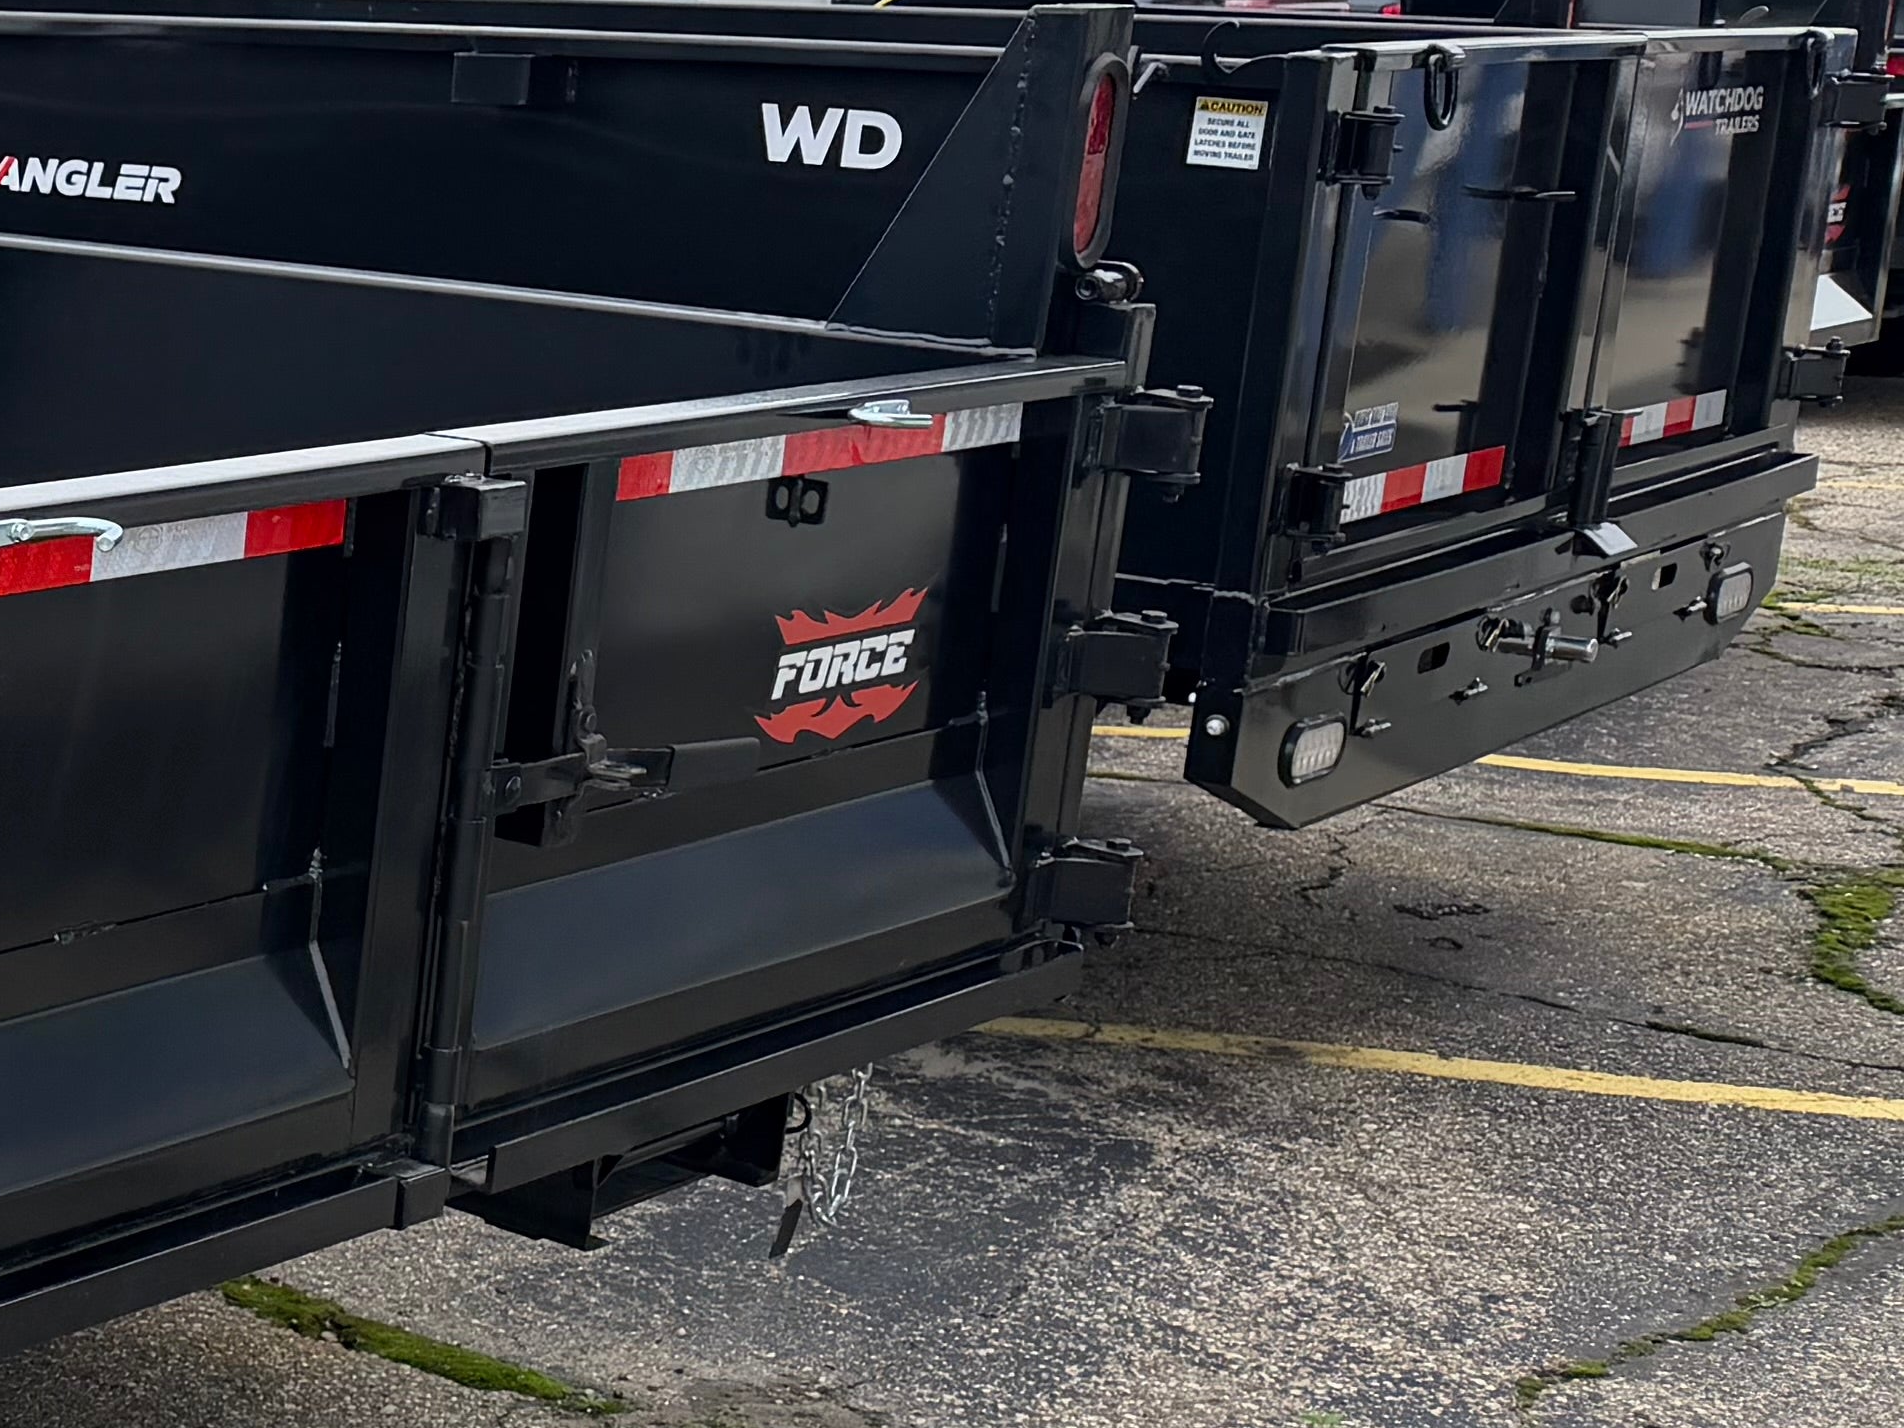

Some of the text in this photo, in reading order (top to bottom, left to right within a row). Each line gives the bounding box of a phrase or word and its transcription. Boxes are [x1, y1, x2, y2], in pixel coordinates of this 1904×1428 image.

[1685, 85, 1765, 116] WATCHDOG
[1210, 102, 1264, 114] CAUTION
[1207, 117, 1250, 128] SECURE ALL
[1715, 114, 1760, 136] TRAILERS
[761, 102, 903, 170] WD
[1220, 129, 1236, 138] AND
[1194, 139, 1256, 150] LATCHES BEFORE
[1223, 151, 1254, 161] TRAILER
[770, 629, 916, 701] FORCE
